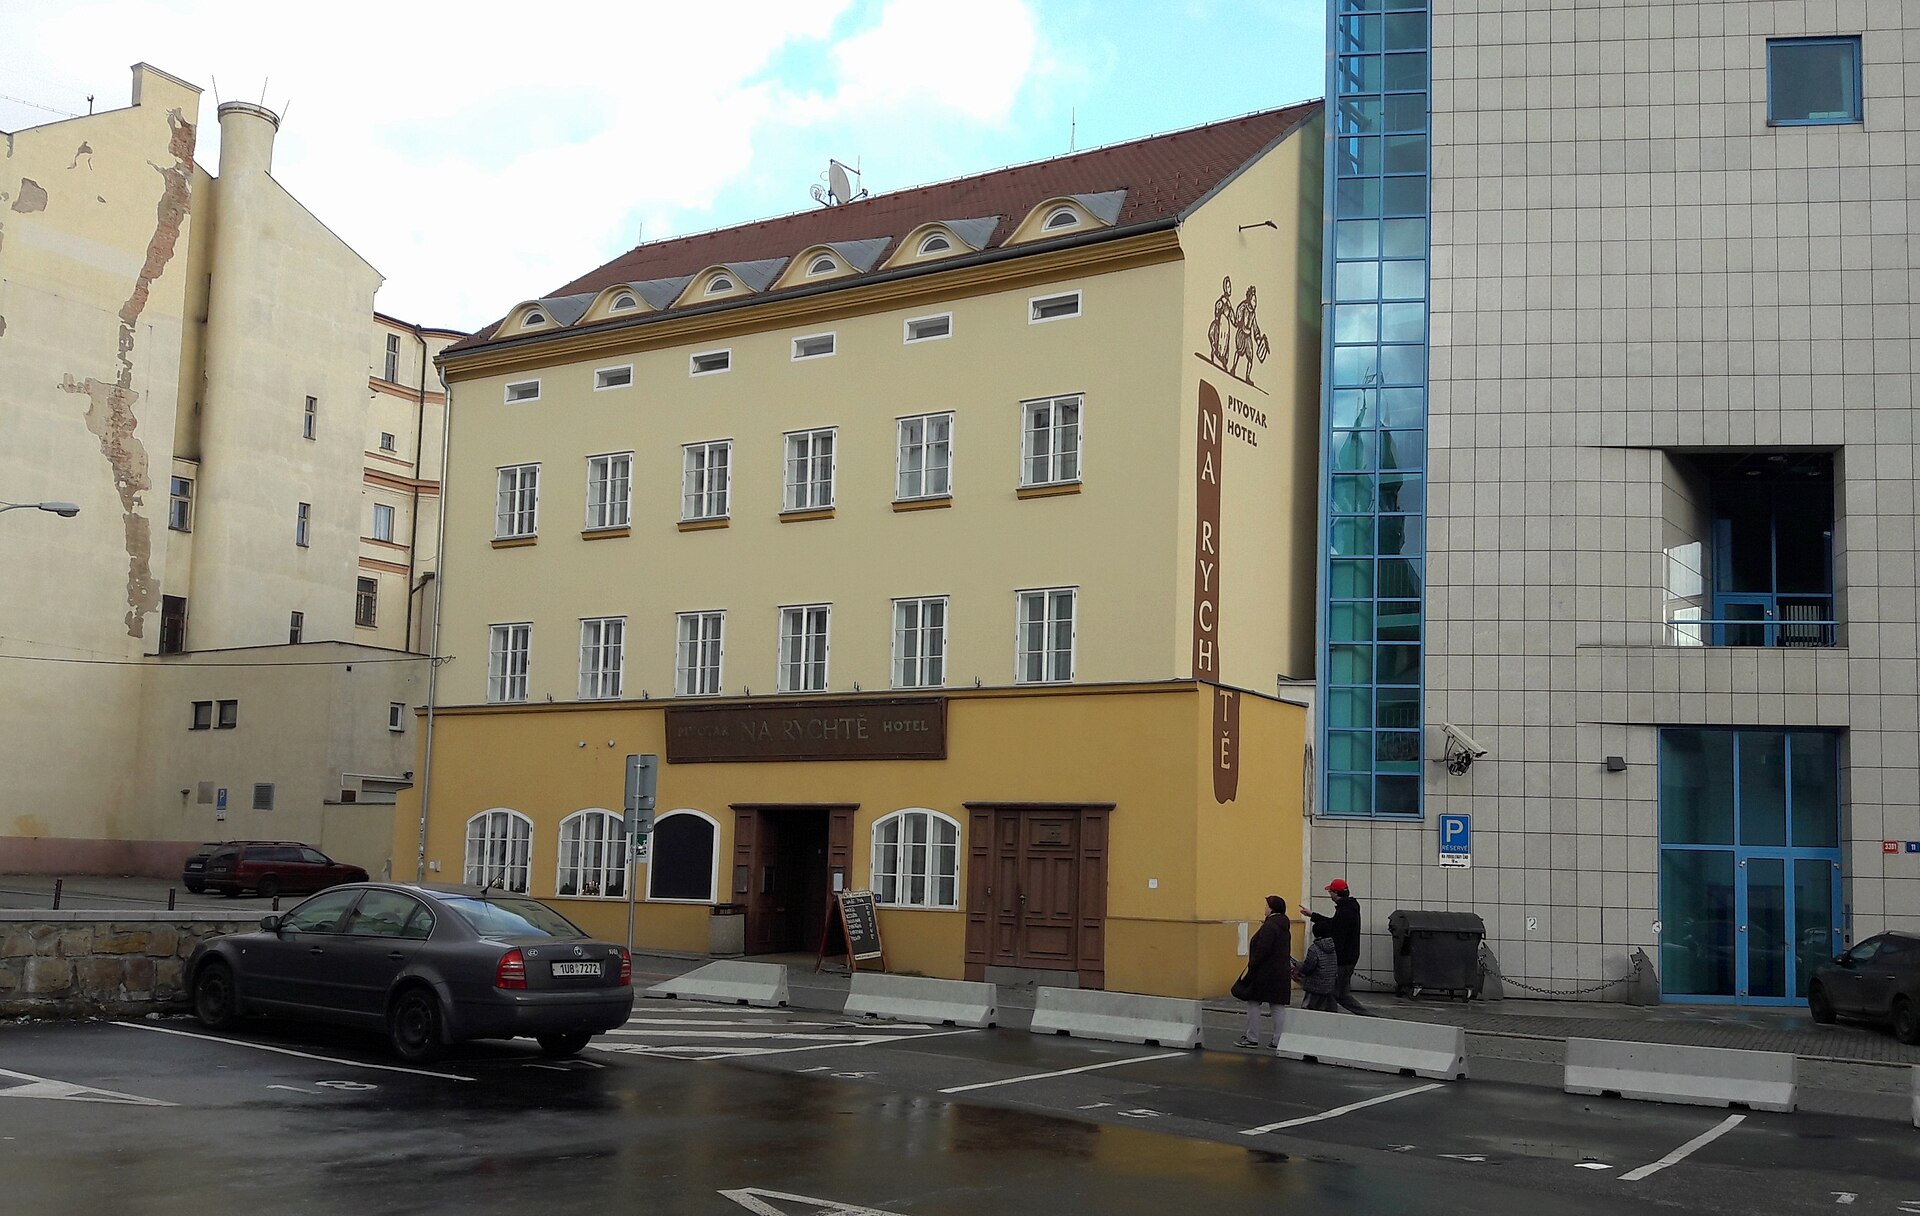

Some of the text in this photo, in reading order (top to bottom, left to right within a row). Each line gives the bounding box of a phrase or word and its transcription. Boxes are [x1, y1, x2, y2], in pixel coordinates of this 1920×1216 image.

[1228, 395, 1267, 428] PIVOVAR
[1227, 419, 1257, 447] HOTEL
[1201, 409, 1217, 485] NA
[740, 720, 774, 742] NA
[882, 719, 929, 733] HOTEL
[1446, 819, 1464, 843] P
[1528, 918, 1537, 930] 2
[560, 963, 598, 974] 1U8 7272
